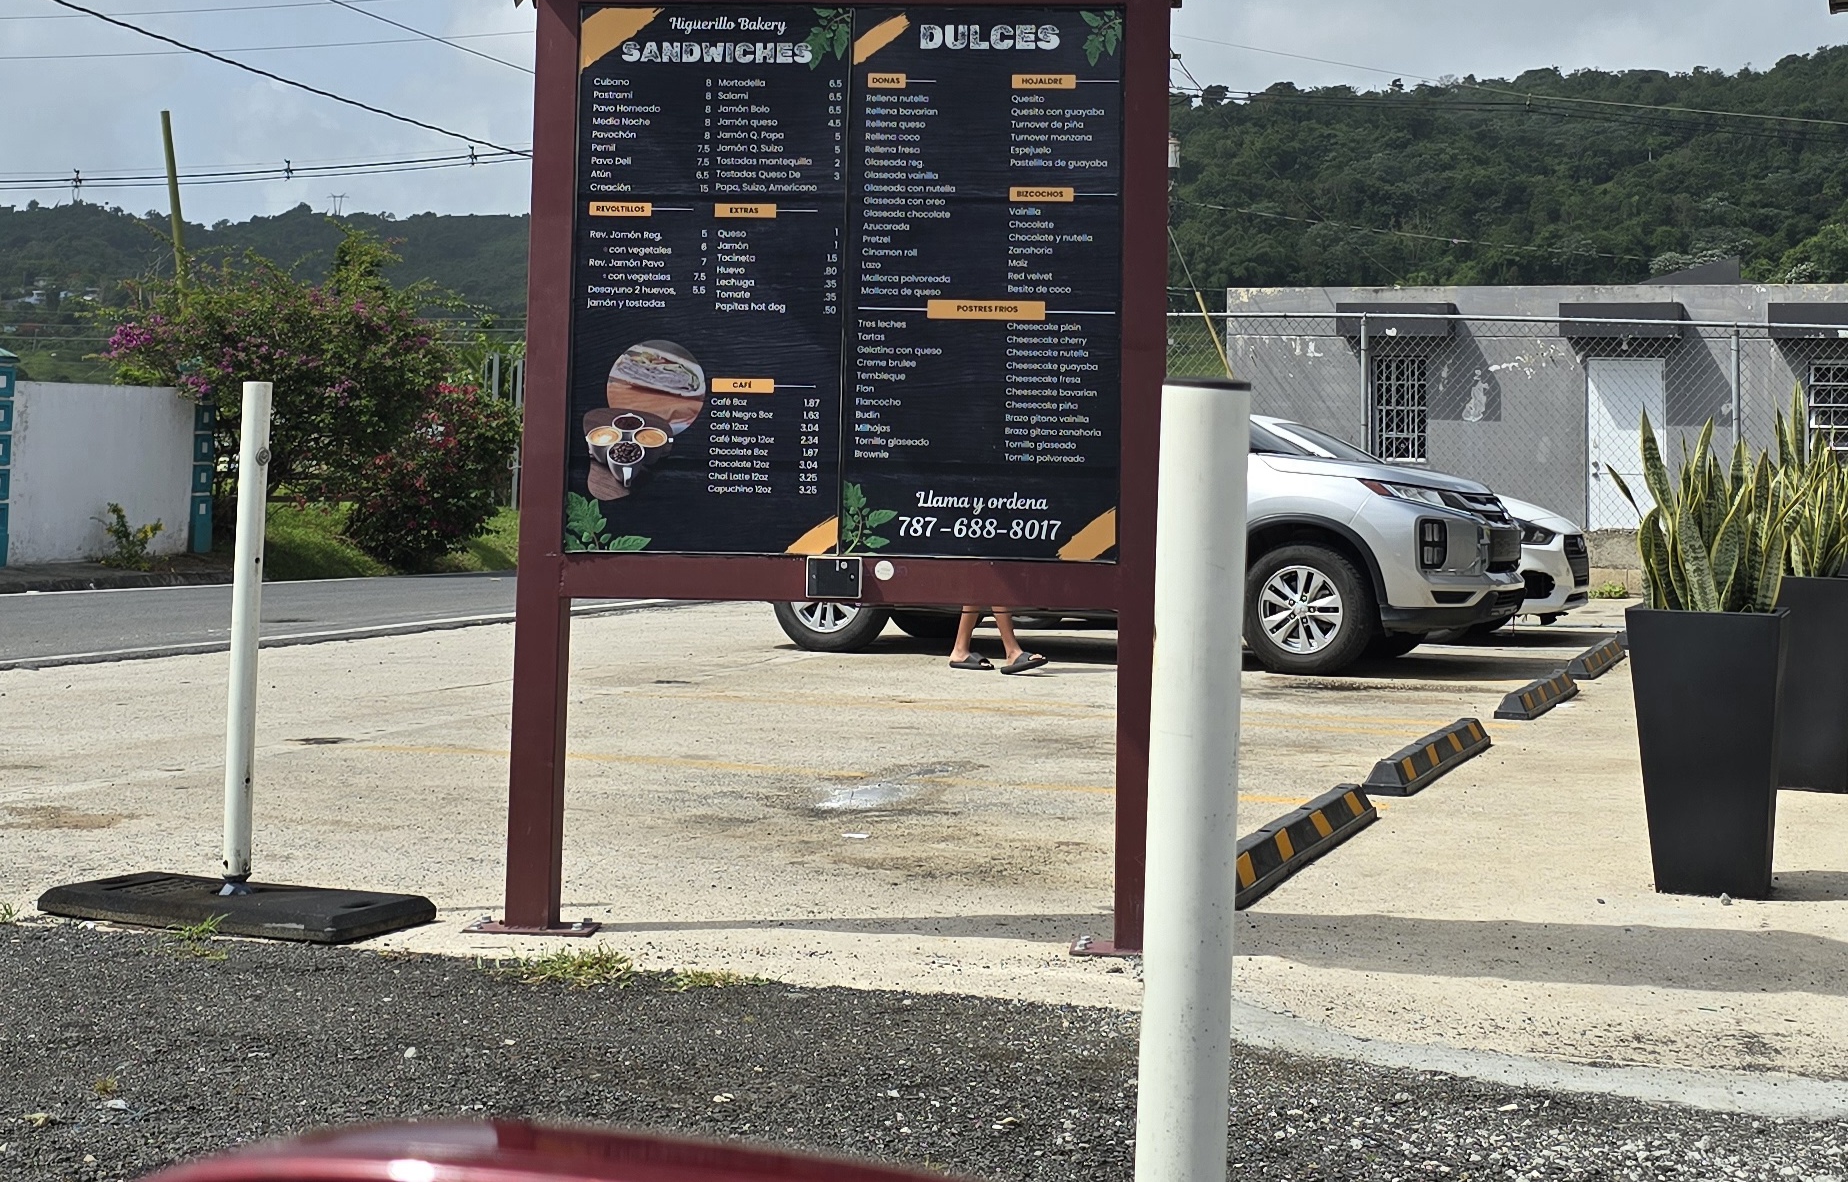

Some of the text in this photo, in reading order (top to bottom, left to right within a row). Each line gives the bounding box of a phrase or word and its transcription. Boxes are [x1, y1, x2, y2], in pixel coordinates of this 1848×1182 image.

[669, 17, 787, 35] Higuerillo Bakery
[920, 25, 1060, 49] DULCES
[622, 42, 812, 64] SANDWICHES
[719, 79, 765, 87] Mortadella
[594, 91, 633, 99] Pastrami
[829, 93, 841, 101] 6.5
[1011, 95, 1044, 103] Quesito
[718, 105, 749, 113] Jamón
[829, 106, 841, 114] 6.5
[1011, 108, 1044, 116] Quesito
[1065, 108, 1104, 117] guayaba
[717, 118, 748, 126] Jamón
[750, 119, 778, 127] queso
[1065, 121, 1083, 130] piña
[592, 131, 636, 139] Pavochón
[717, 131, 748, 139] Jamón
[761, 132, 784, 141] Papa
[698, 145, 710, 153] 7.5
[717, 144, 748, 152] Jamón
[835, 146, 840, 154] 5
[1011, 146, 1051, 156] Espejuelo
[615, 157, 631, 165] Deli
[697, 158, 709, 166] 7.5
[717, 157, 756, 165] Tostadas
[1068, 160, 1107, 169] guayaba
[591, 170, 709, 179] Atún 6.5
[716, 170, 756, 178] Tostadas
[700, 184, 708, 192] 15
[863, 223, 910, 231] Azucarada
[718, 228, 838, 238] Queso 1
[717, 241, 838, 250] Jamón 1
[628, 247, 672, 256] vegetales
[862, 248, 902, 256] Cinamon
[862, 261, 881, 269] Lazo
[914, 289, 941, 297] queso
[715, 303, 749, 312] Papitas
[751, 303, 765, 311] hot
[768, 303, 786, 313] dog
[1060, 337, 1087, 346] cherry
[915, 348, 942, 356] queso
[733, 411, 757, 420] Negro
[800, 424, 819, 432] 3.04
[1005, 427, 1028, 435] Brazo
[710, 435, 730, 443] Café
[732, 436, 756, 445] Negro
[801, 436, 818, 444] 2.34
[799, 461, 818, 469] 3.04
[708, 485, 753, 494] Capuchino
[799, 486, 817, 494] 3.25
[916, 490, 1048, 514] Llama y ordena
[899, 517, 1061, 540] 787-688-8017
